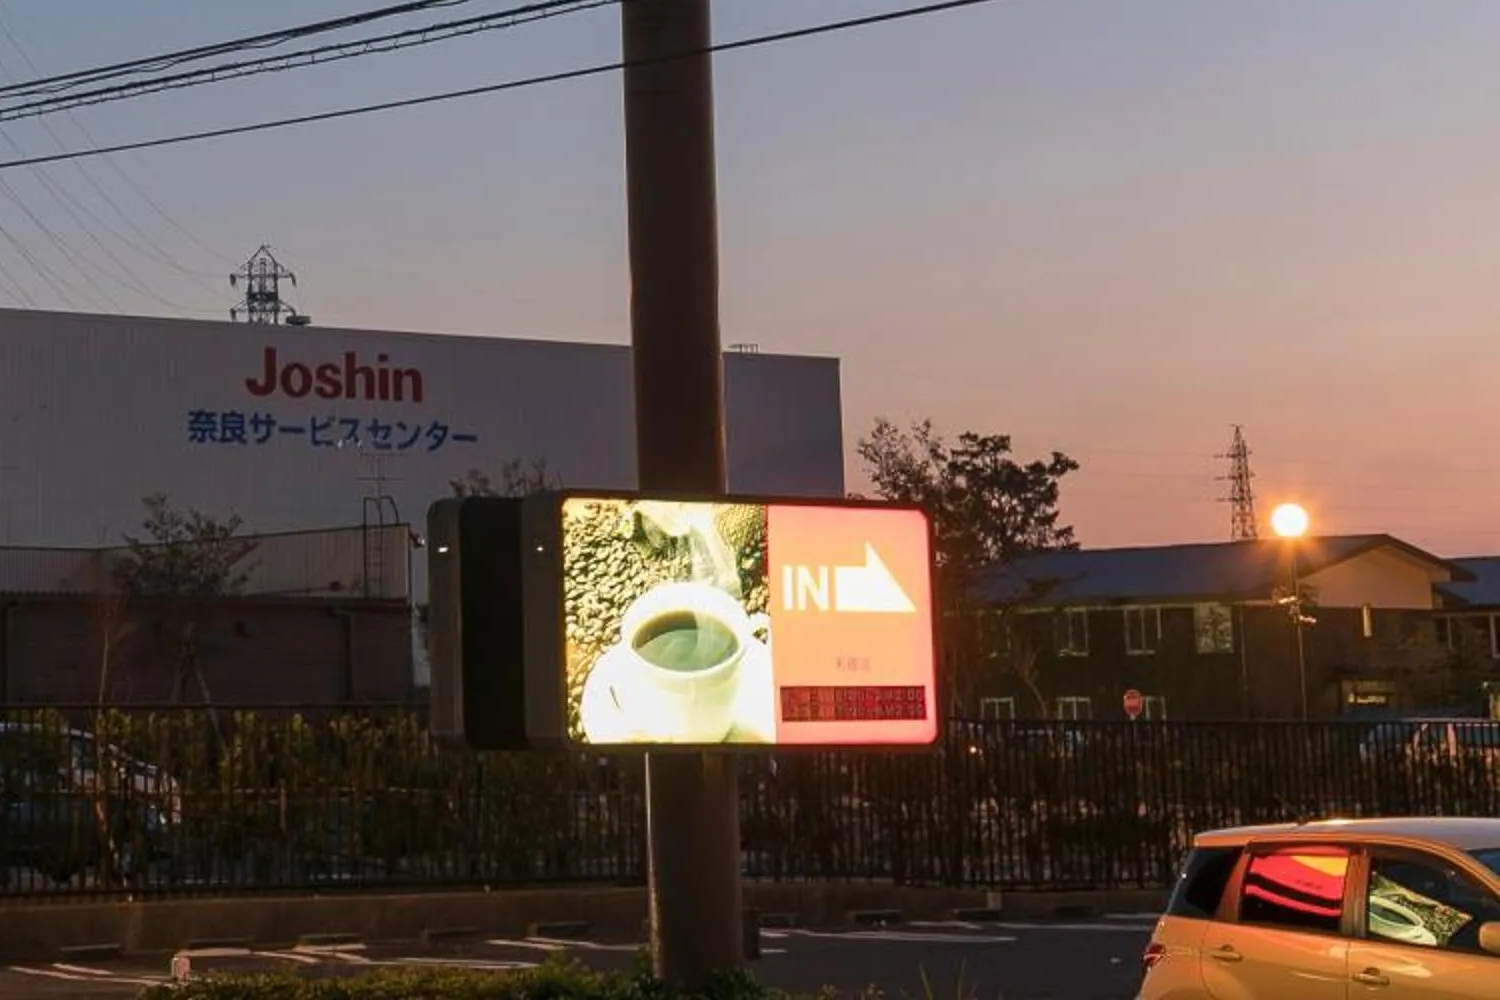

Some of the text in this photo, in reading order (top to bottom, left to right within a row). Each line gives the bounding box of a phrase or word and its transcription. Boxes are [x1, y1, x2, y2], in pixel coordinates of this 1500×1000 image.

[245, 347, 424, 403] Joshin
[188, 410, 477, 452] 奈良サービスセンター
[781, 566, 831, 612] IN
